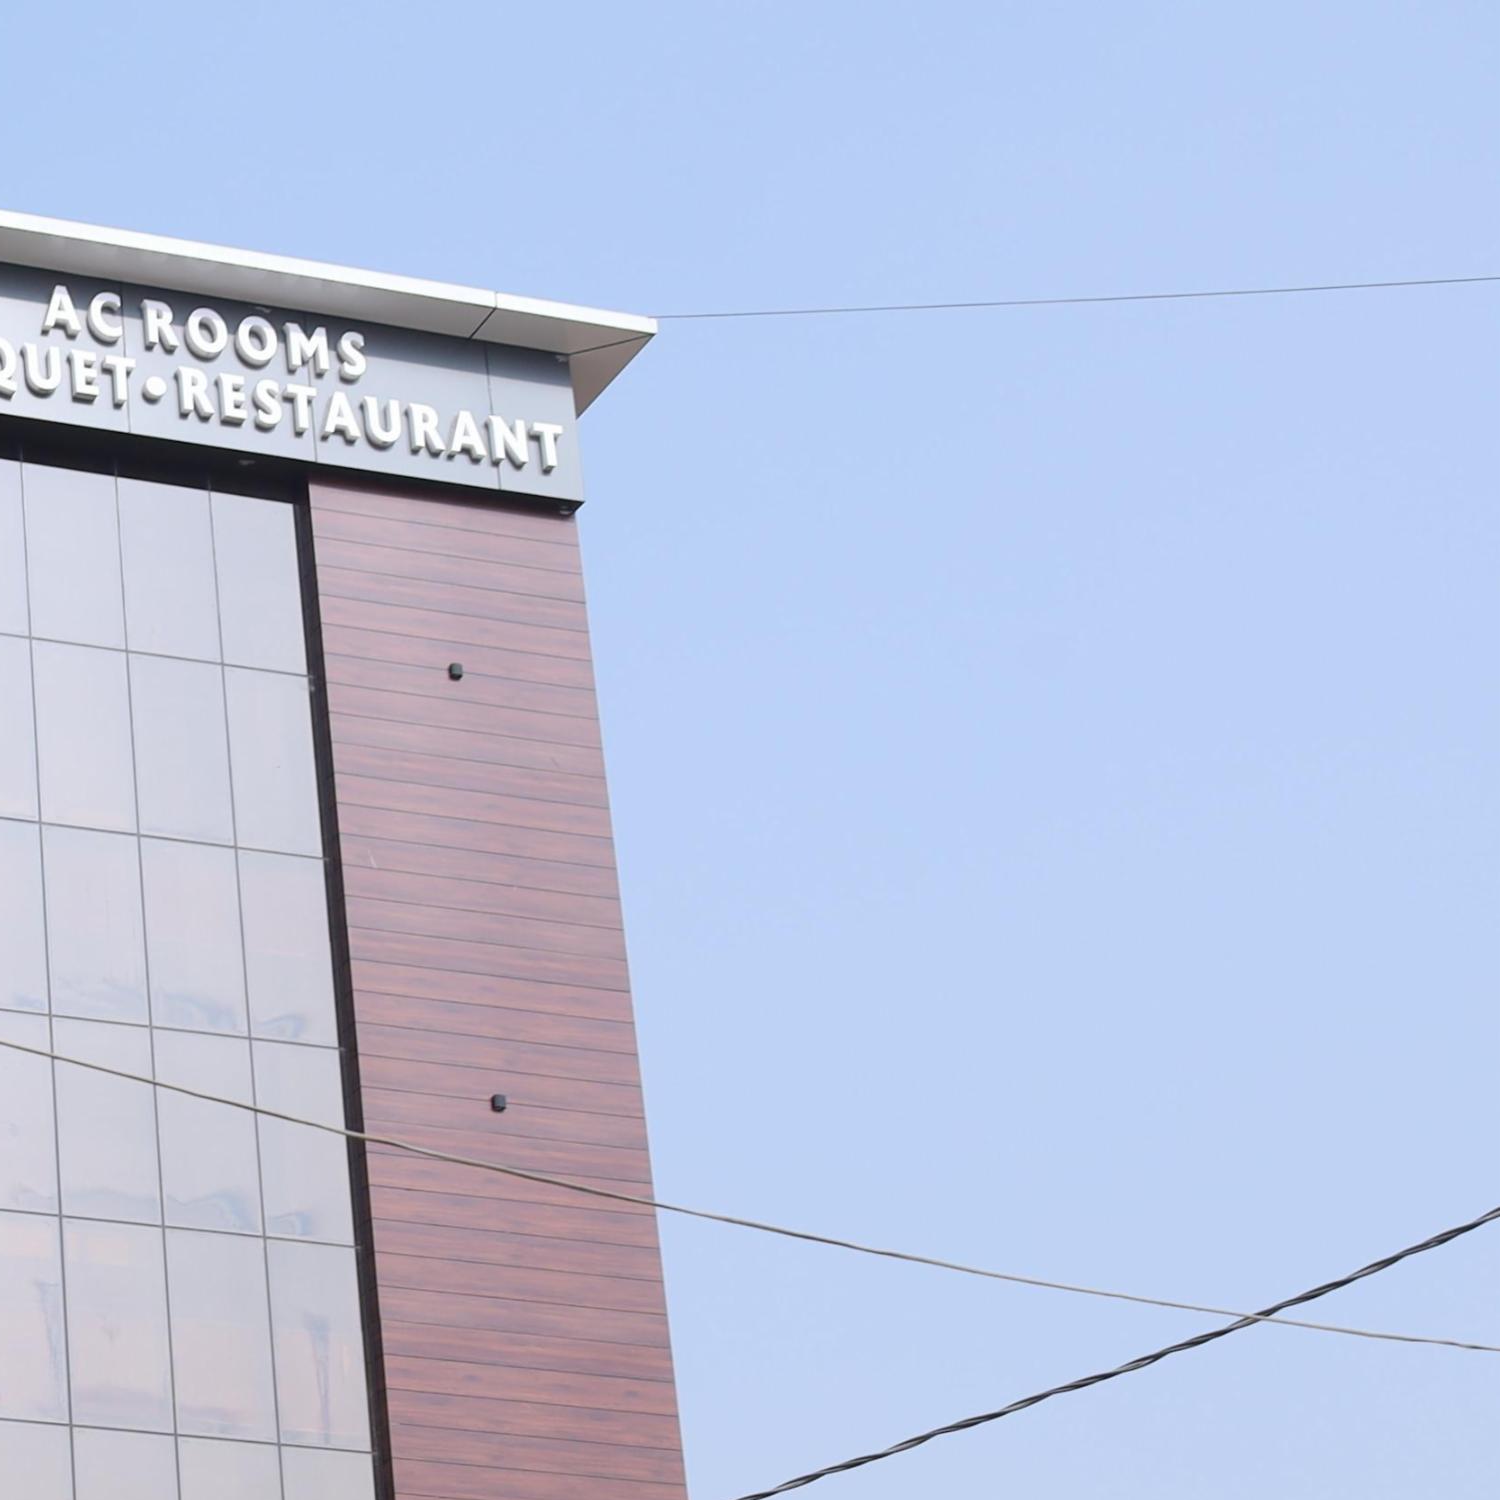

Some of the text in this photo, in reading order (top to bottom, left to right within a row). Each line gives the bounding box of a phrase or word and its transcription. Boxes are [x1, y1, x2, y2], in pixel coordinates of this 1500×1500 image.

[41, 284, 368, 382] AC ROOMS
[177, 365, 564, 474] RESTAURANT
